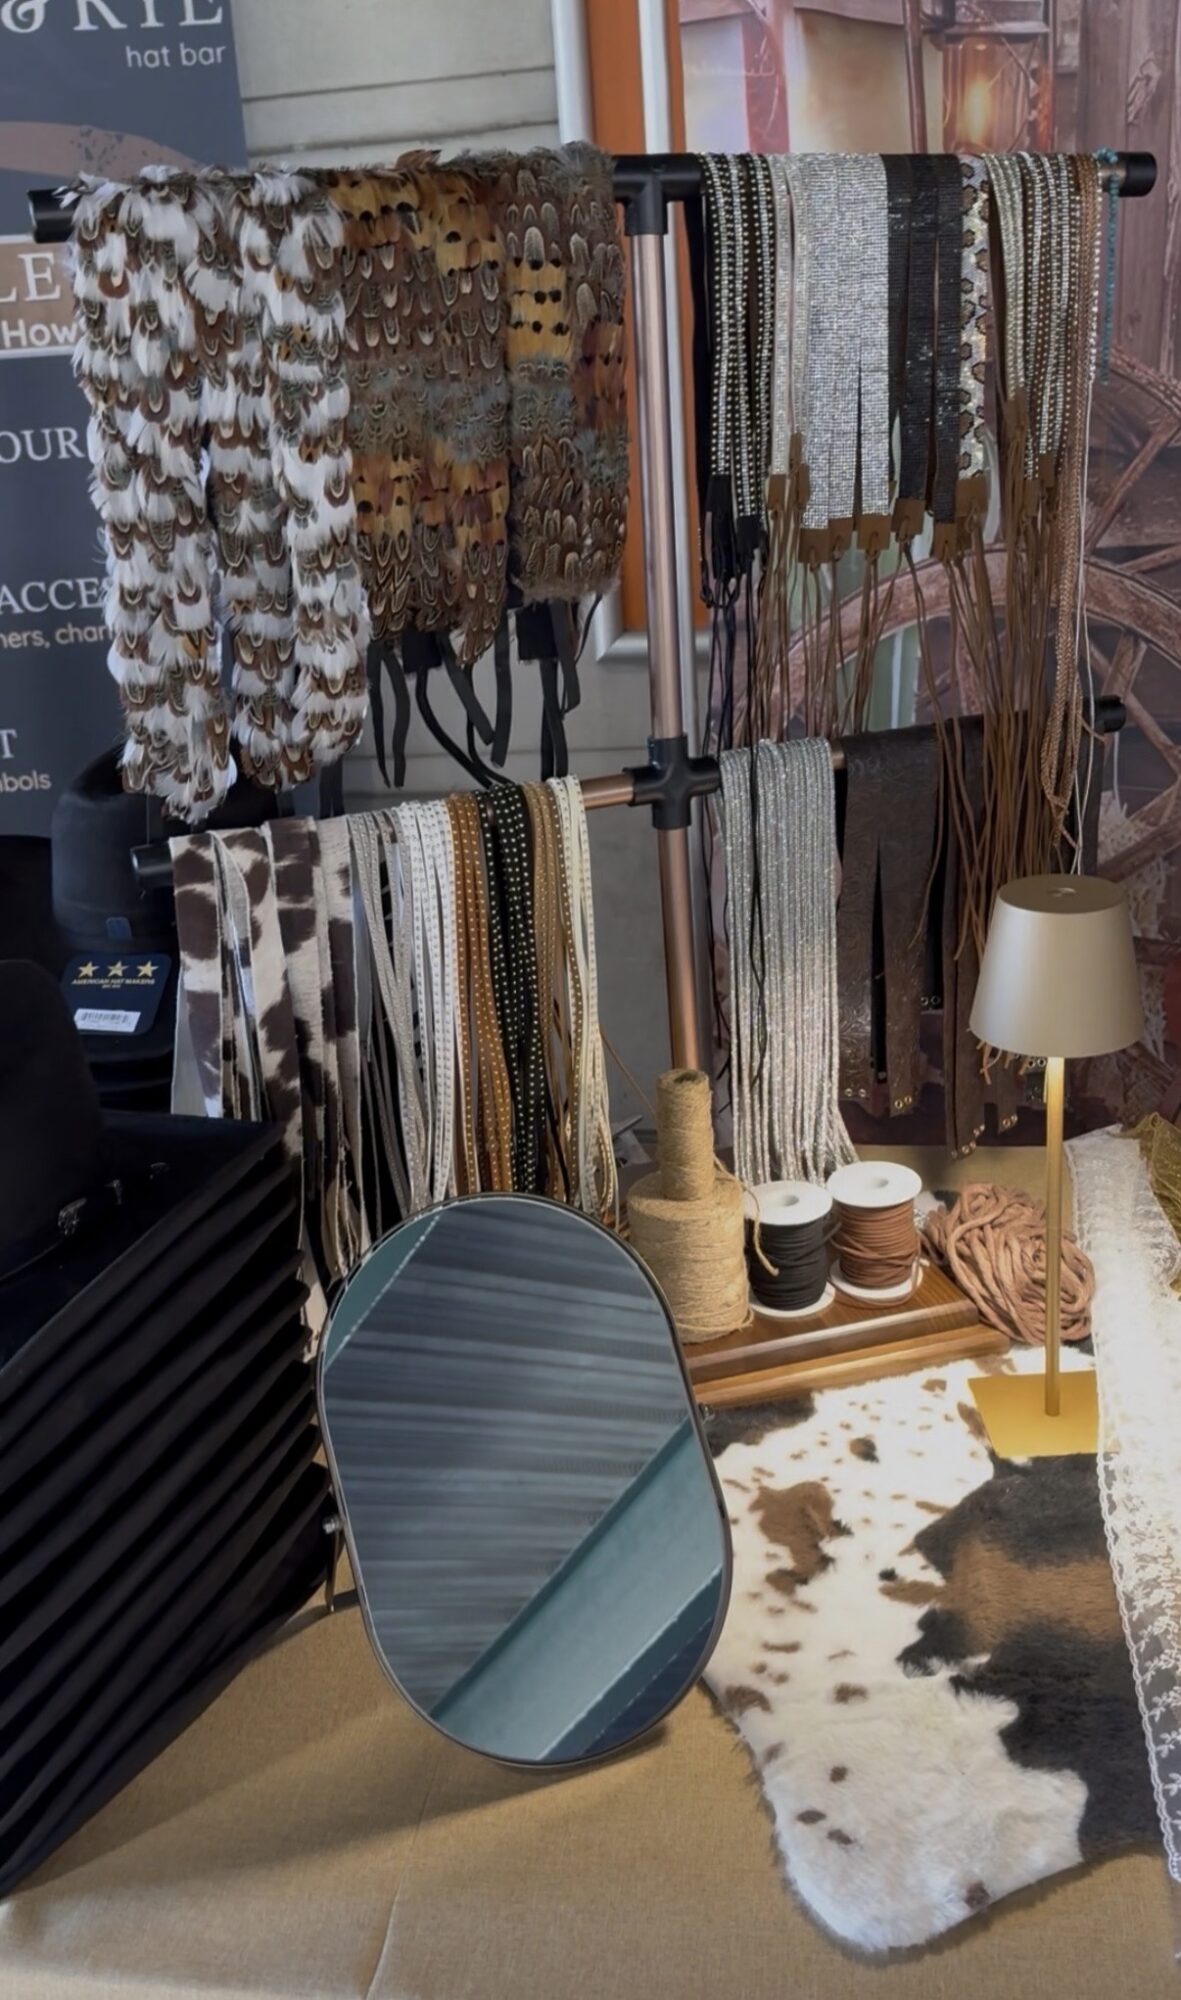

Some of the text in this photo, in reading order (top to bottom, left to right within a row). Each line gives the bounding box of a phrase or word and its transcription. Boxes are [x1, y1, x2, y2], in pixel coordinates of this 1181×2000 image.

[125, 42, 226, 68] hat bar
[0, 427, 86, 464] OUR
[0, 769, 52, 792] bols
